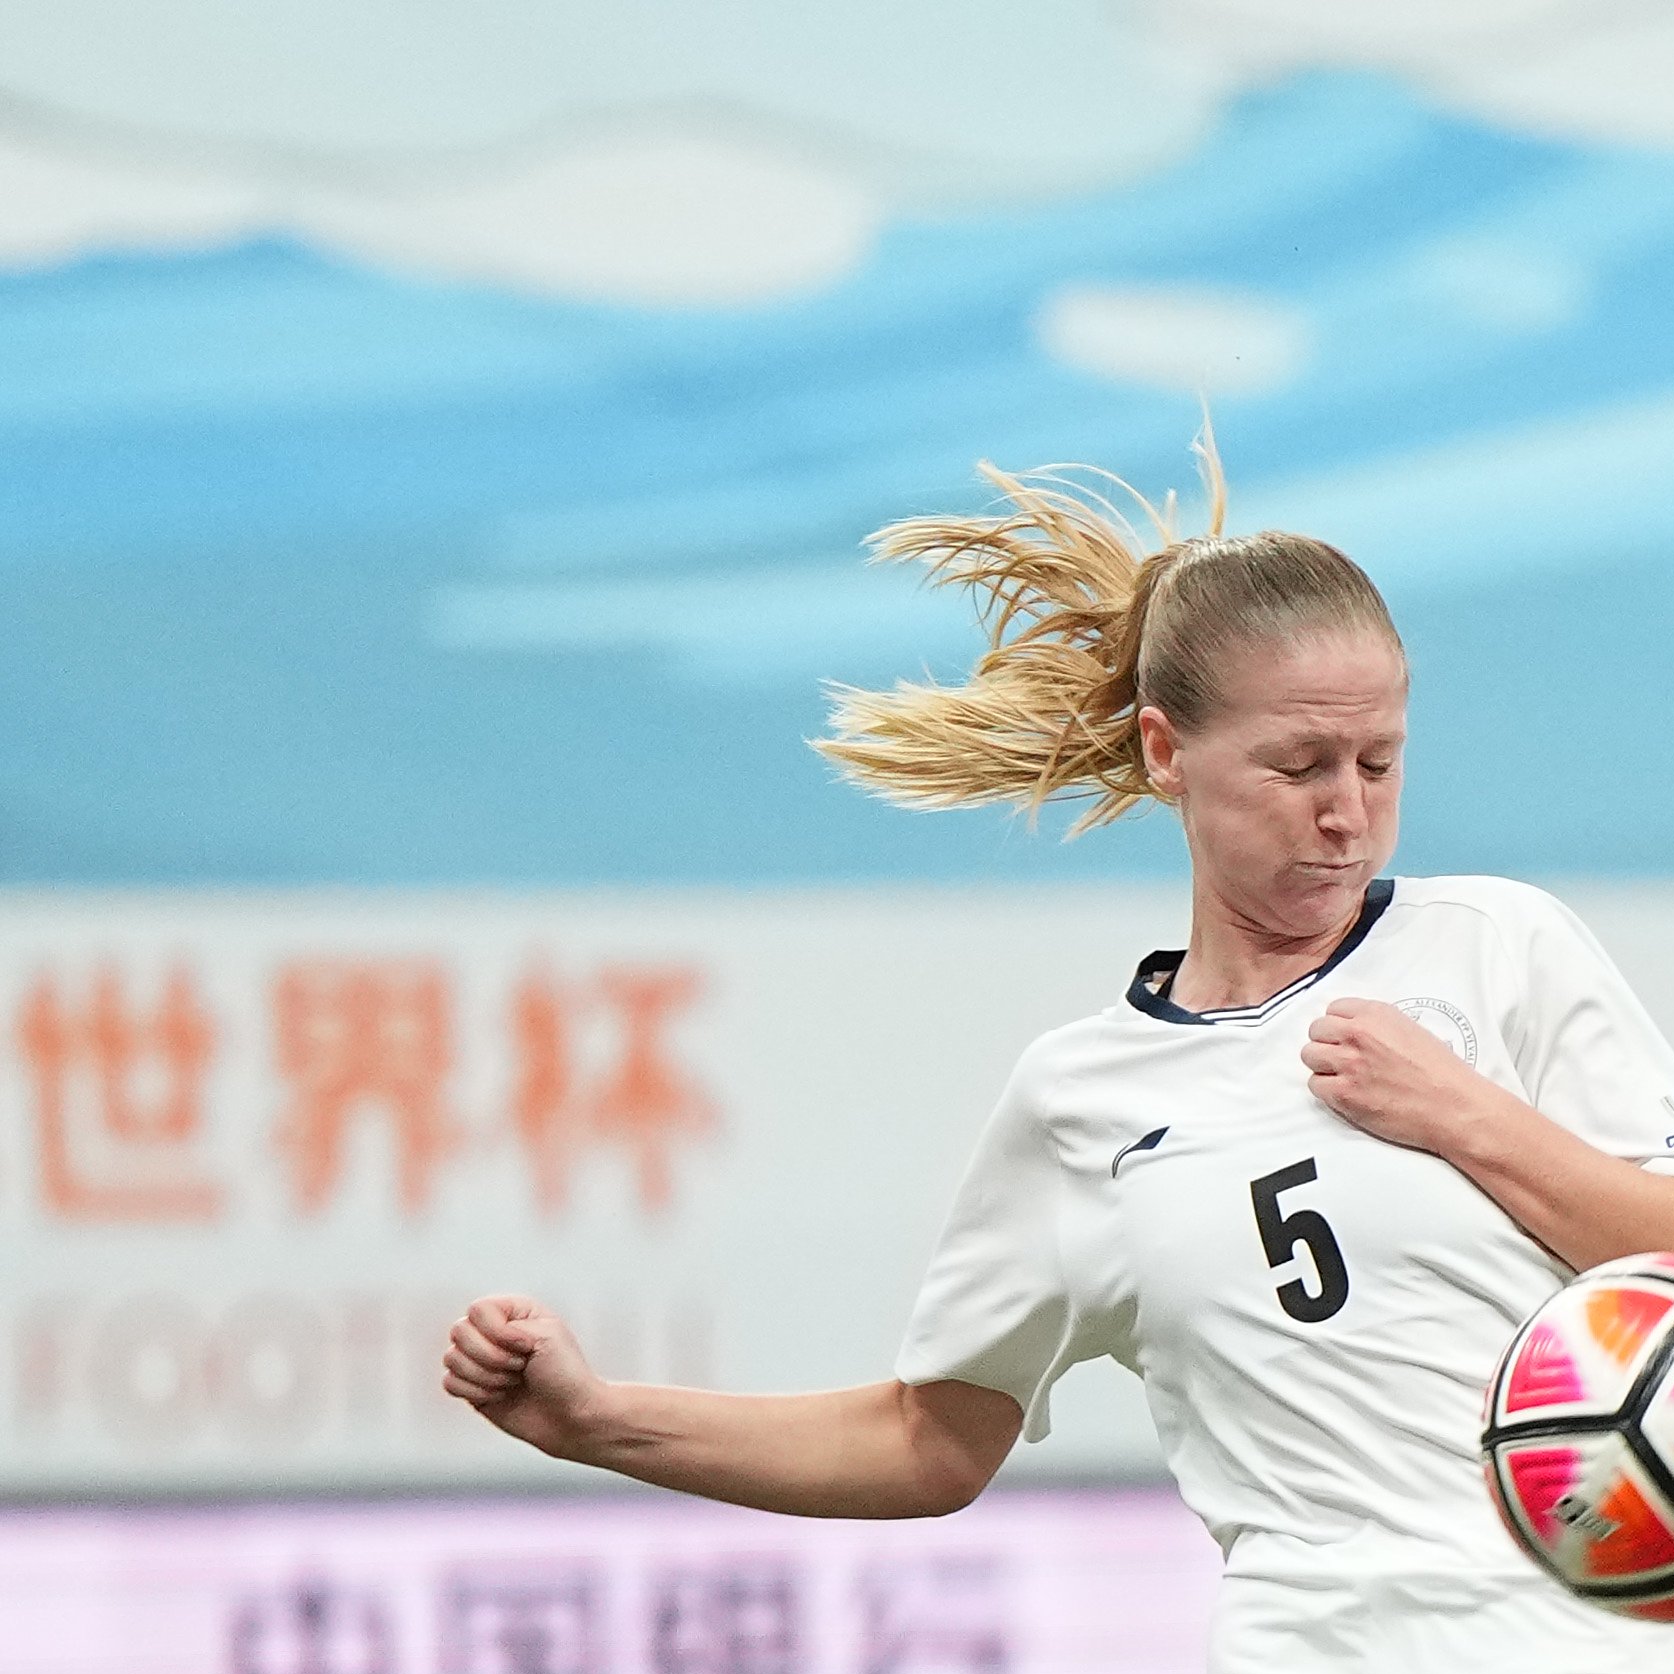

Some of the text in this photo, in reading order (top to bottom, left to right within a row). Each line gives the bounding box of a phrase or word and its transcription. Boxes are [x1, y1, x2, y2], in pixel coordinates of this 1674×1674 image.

[14, 953, 722, 1226] 世界杯
[1250, 1156, 1350, 1324] 5
